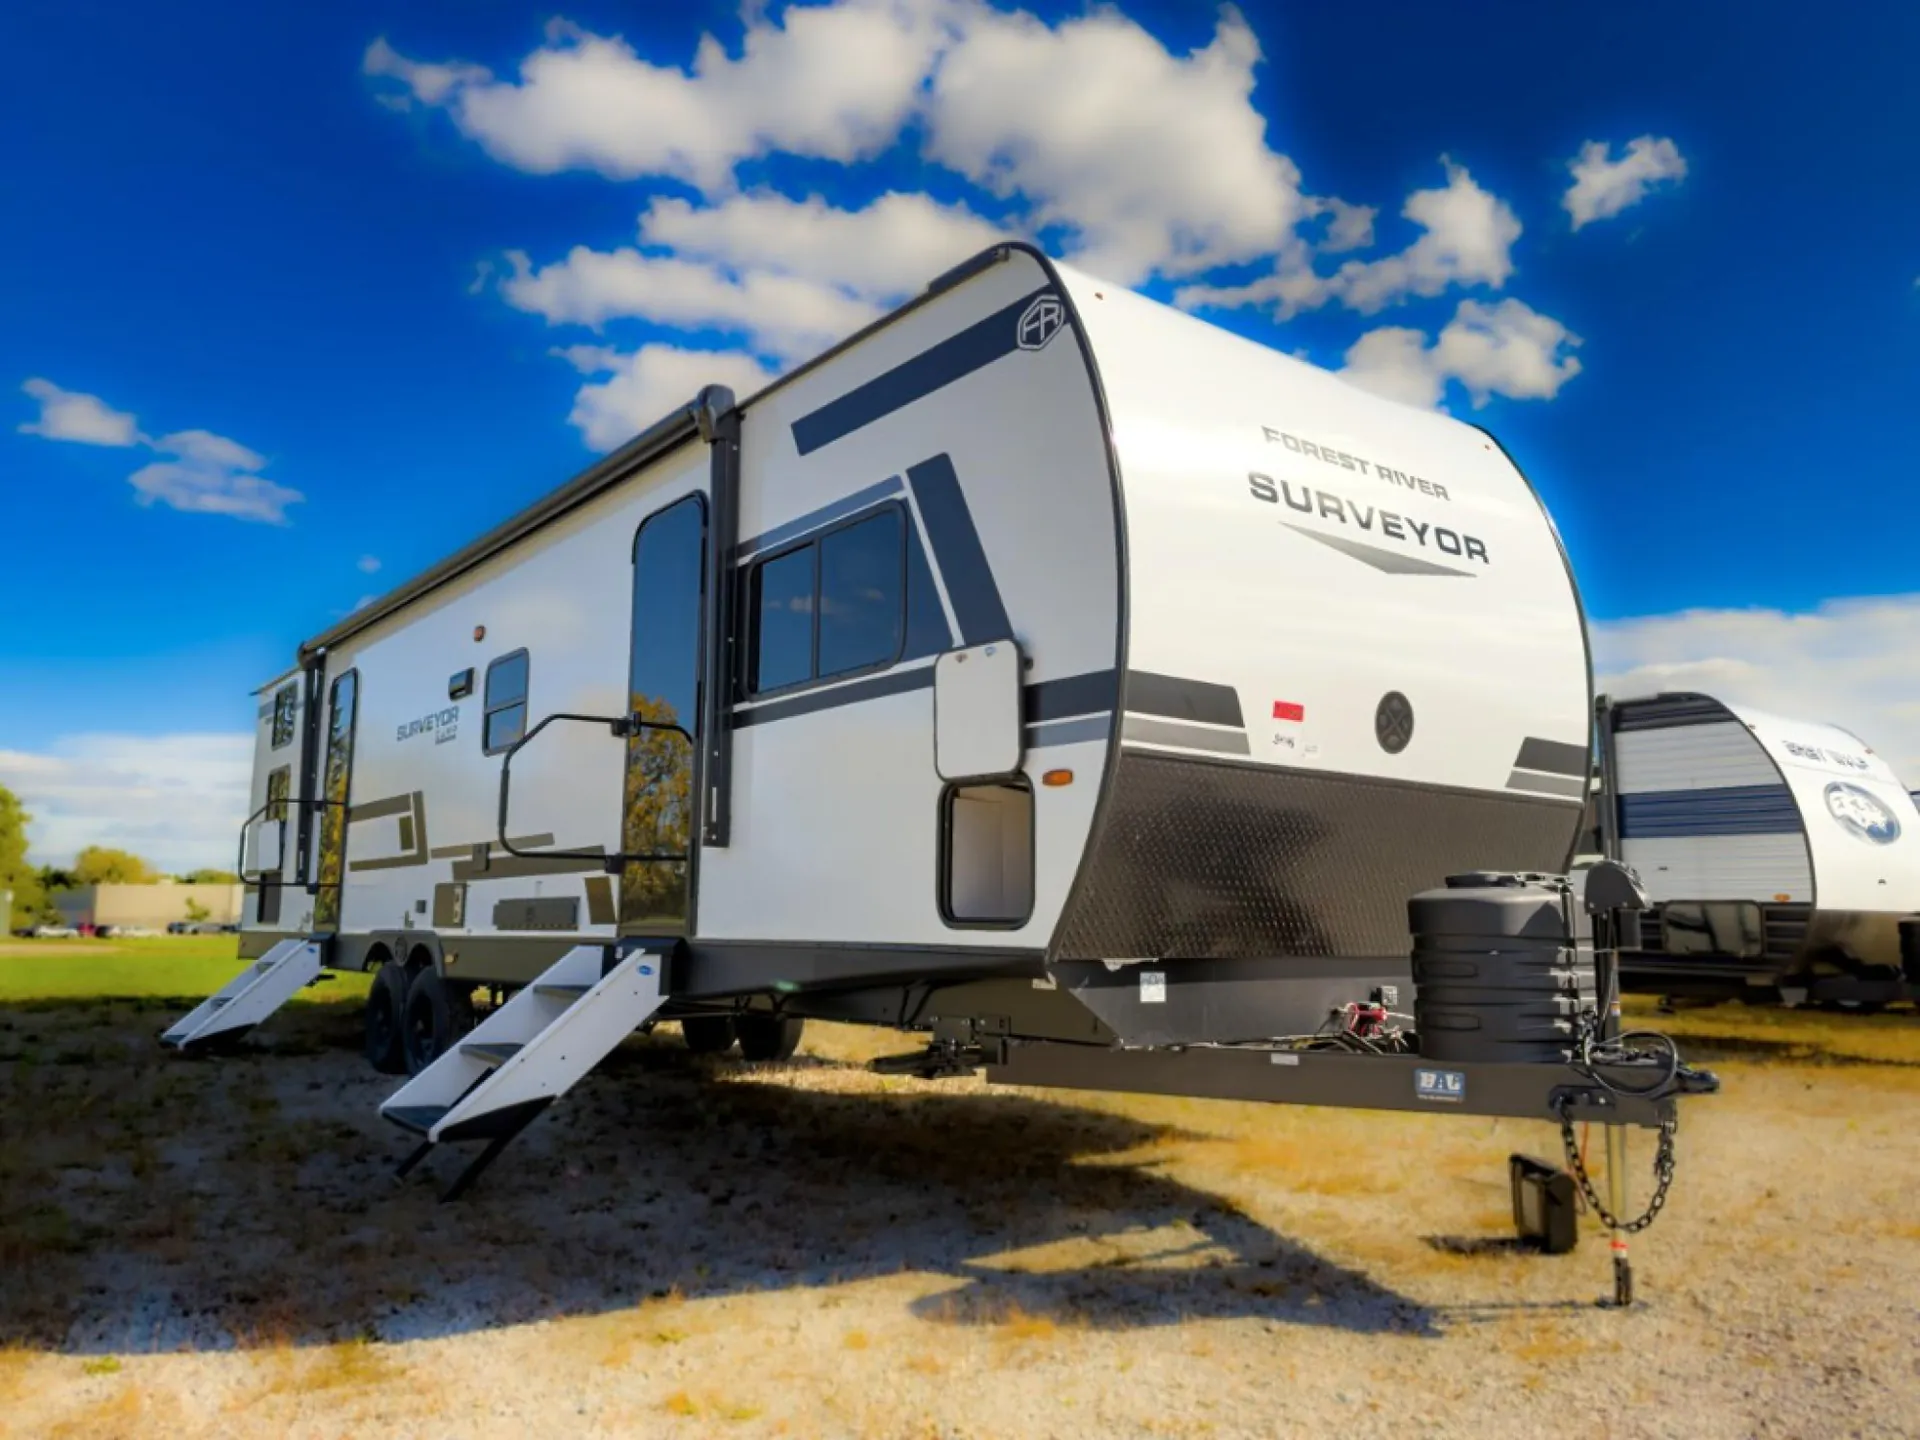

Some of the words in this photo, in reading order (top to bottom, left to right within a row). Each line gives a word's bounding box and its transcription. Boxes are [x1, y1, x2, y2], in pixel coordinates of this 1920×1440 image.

[1261, 425, 1370, 475] FOREST
[1374, 463, 1451, 501] RIVER
[1248, 471, 1490, 564] SURVEYOR
[396, 705, 459, 742] SURVEYOR
